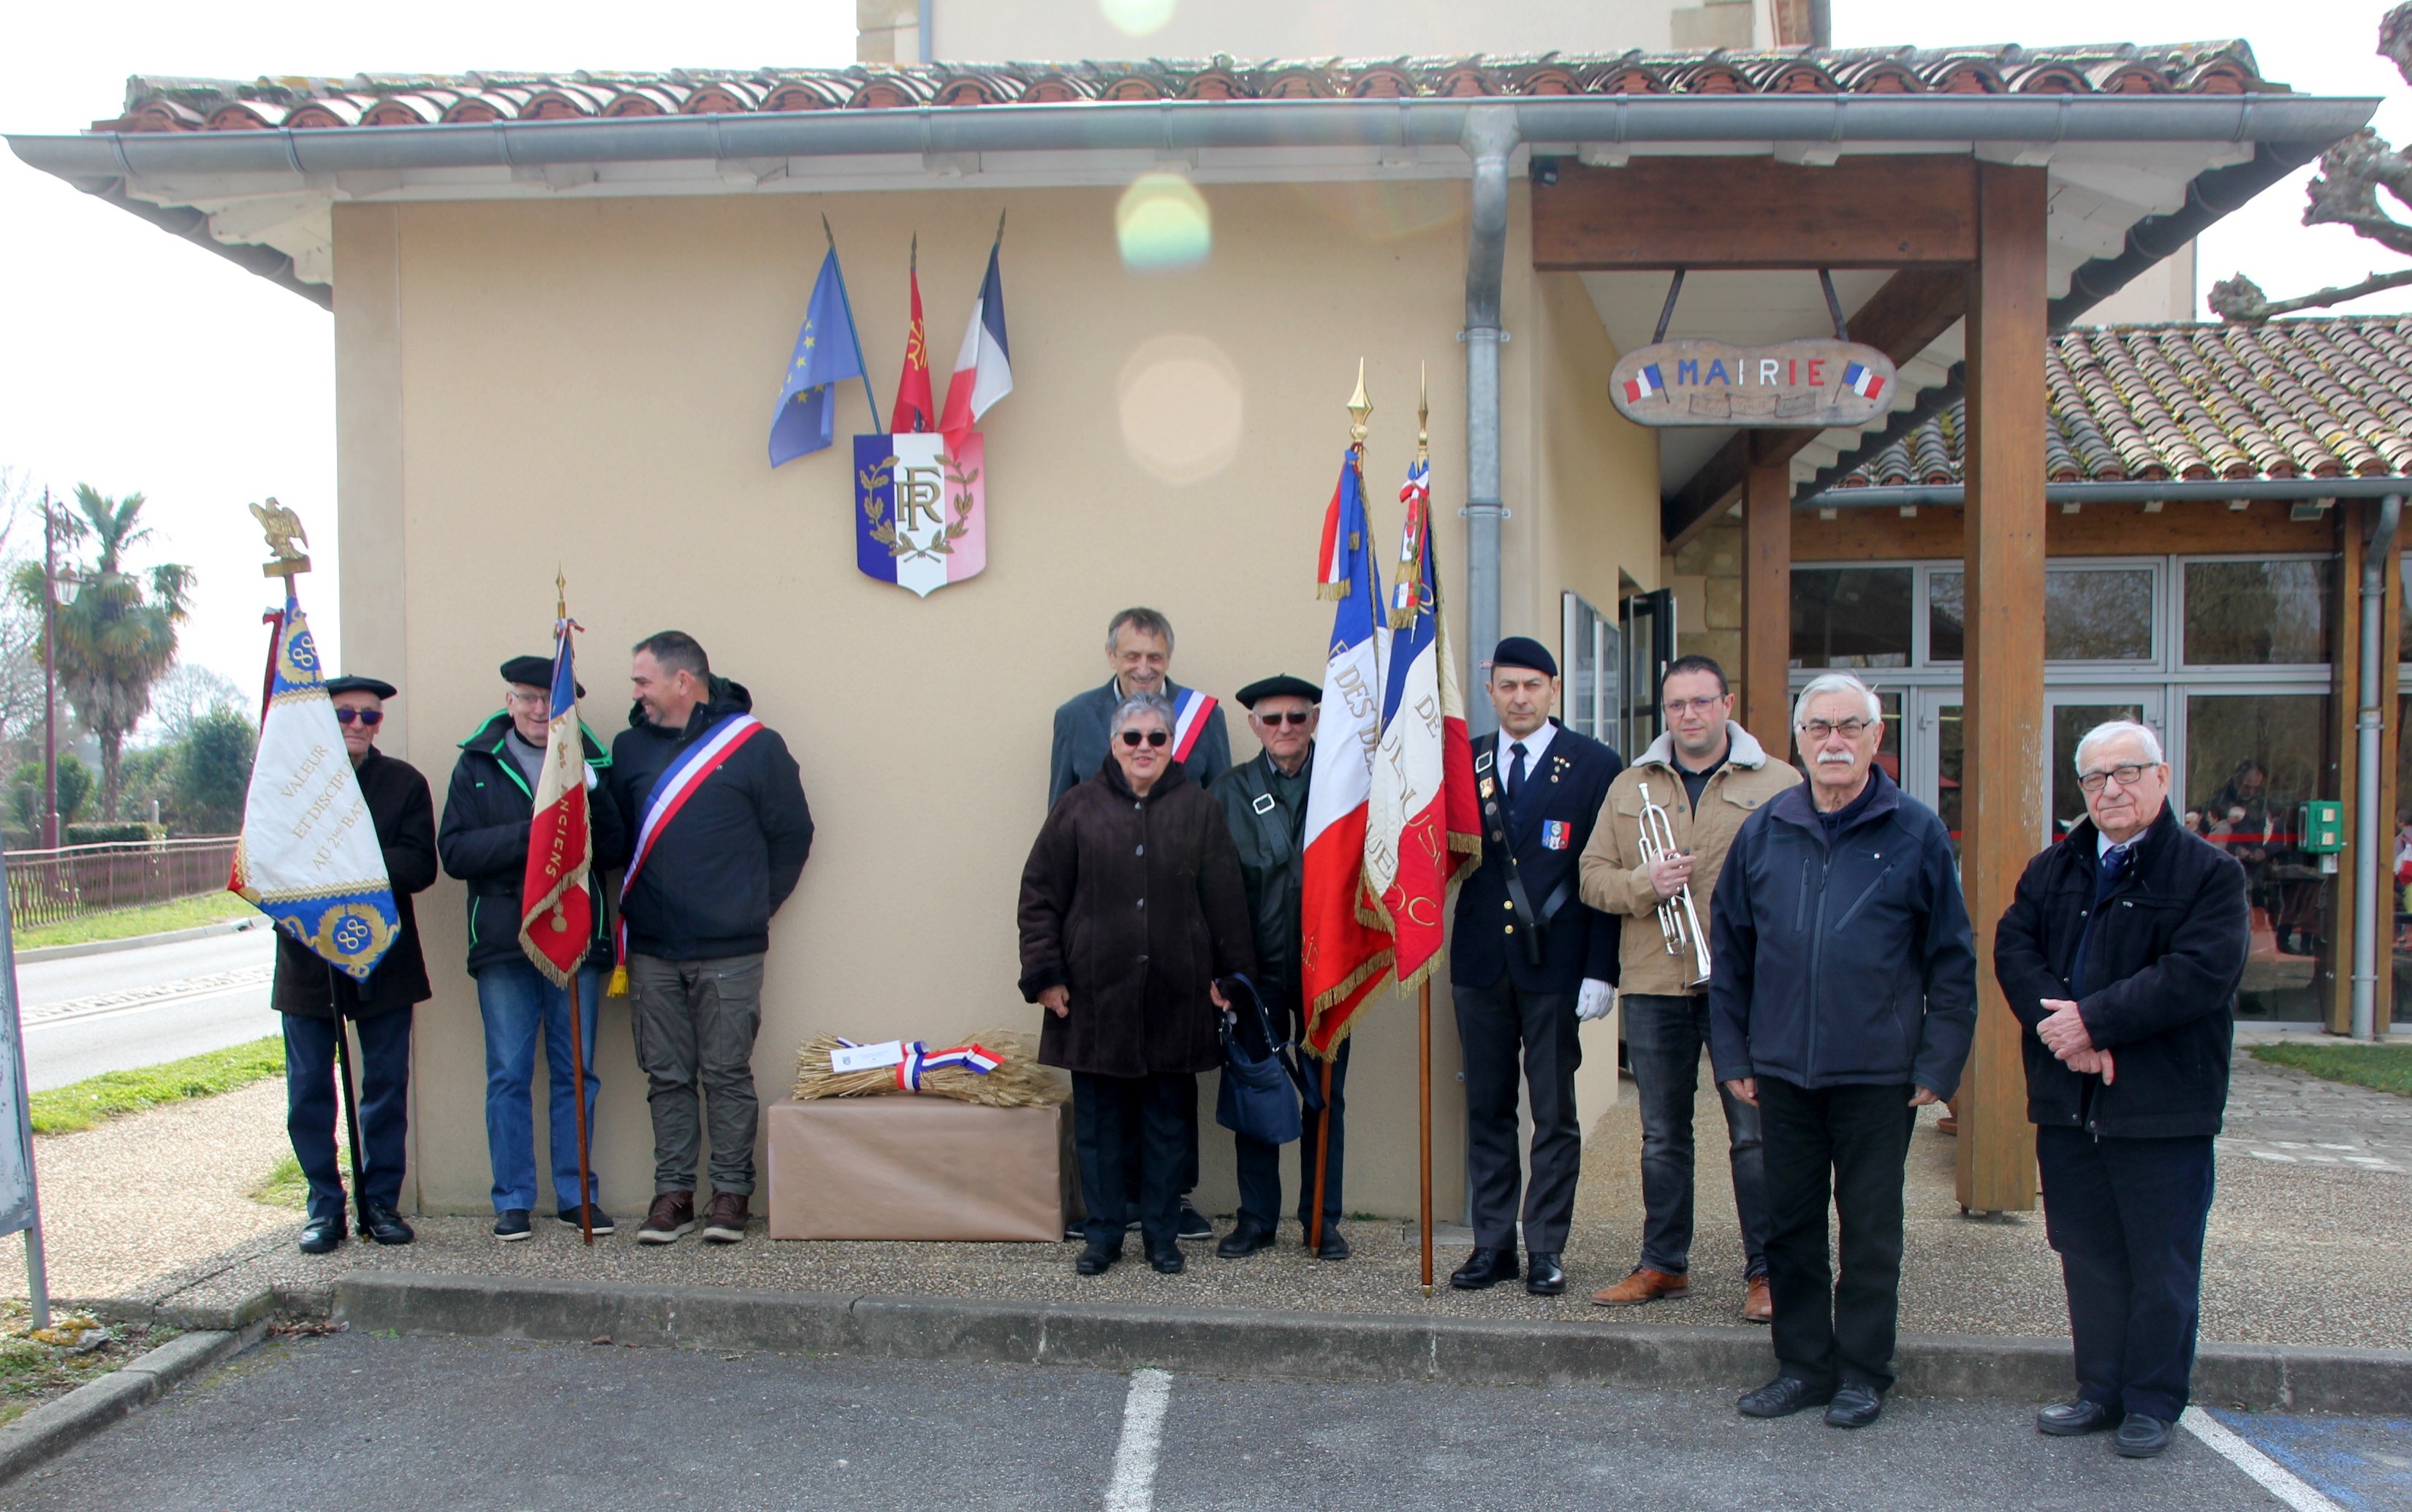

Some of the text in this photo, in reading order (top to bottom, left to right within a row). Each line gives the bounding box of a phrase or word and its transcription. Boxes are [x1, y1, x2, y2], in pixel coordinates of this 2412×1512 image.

[1678, 358, 1825, 386] MAIRIE
[895, 466, 942, 531] RF
[1335, 665, 1376, 718] DES
[1415, 694, 1441, 738] DE
[281, 745, 328, 798] VALEUR
[292, 758, 354, 840] ET DISCIPLI
[545, 783, 572, 878] ANCIENS
[312, 845, 332, 871] AU
[338, 919, 368, 949] 88
